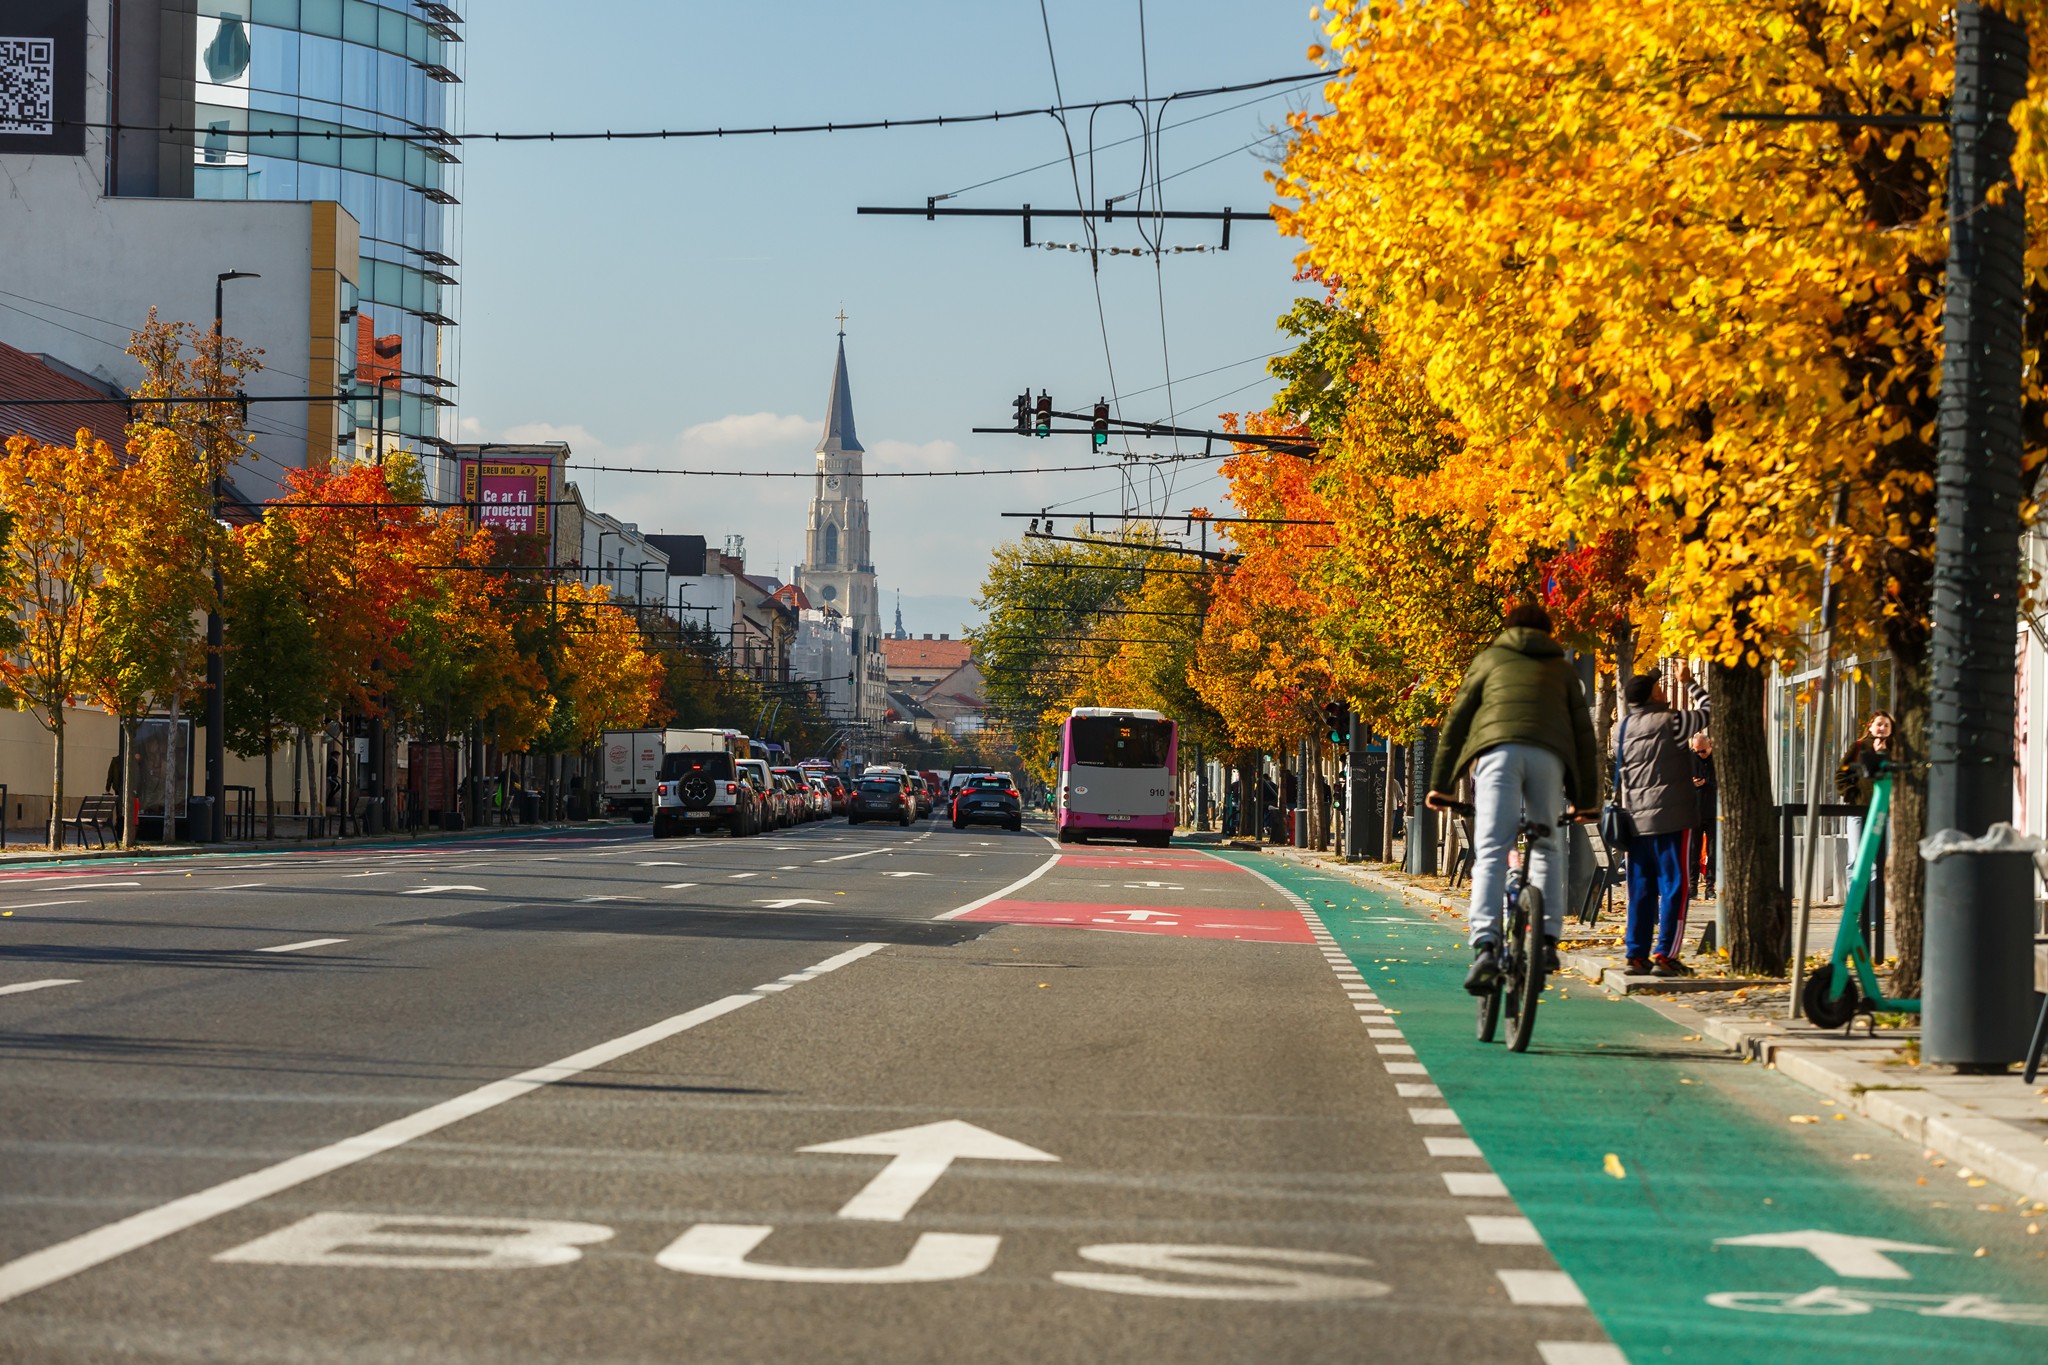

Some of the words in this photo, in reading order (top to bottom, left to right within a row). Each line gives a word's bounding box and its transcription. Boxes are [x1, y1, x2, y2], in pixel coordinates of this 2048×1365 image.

[483, 490, 497, 502] Ce
[501, 492, 513, 502] ar
[518, 490, 527, 502] fi
[505, 518, 526, 531] fără
[1150, 789, 1165, 797] 910
[212, 1210, 1391, 1302] BUS
